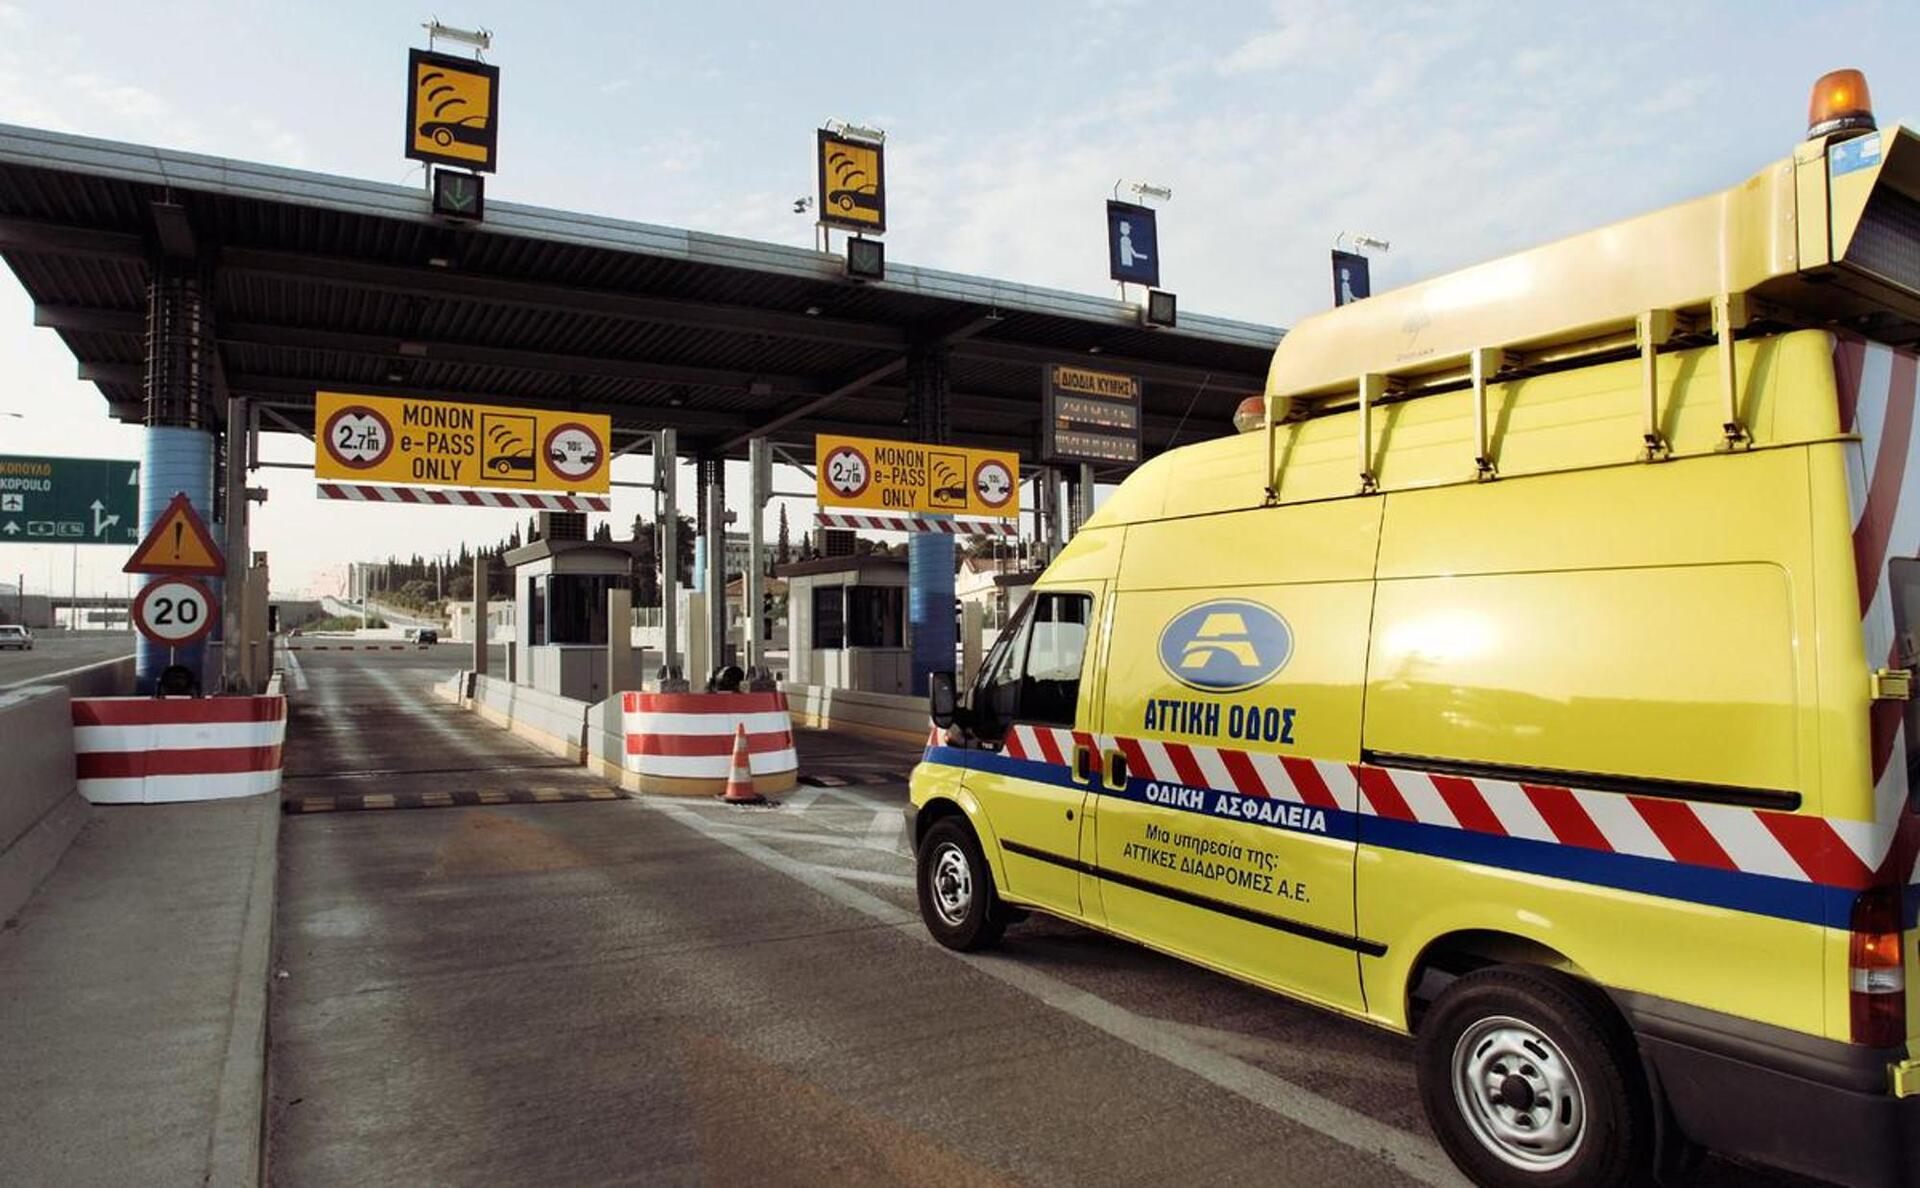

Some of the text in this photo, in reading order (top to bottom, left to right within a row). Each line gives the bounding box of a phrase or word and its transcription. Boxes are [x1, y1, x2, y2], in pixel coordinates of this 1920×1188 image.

[339, 425, 366, 450] 2.7
[401, 432, 475, 456] e-PASS
[412, 457, 462, 481] ONLY
[874, 468, 926, 487] e-PASS
[882, 488, 917, 508] ONLY
[154, 598, 198, 625] 20
[1144, 699, 1297, 744] ΑΤΤΙΚΗ ΟΔΟΣ
[1146, 783, 1327, 833] ΟΔΙΚΗ ΑΣΦΑΛΕΙΑ
[1145, 824, 1170, 843] Μια
[1174, 833, 1242, 861] υπηρεσία
[1123, 842, 1310, 903] ΑΤΤΙΚΕΣ ΔΙΑΔΡΟΜΕΣ Α.Ε.
